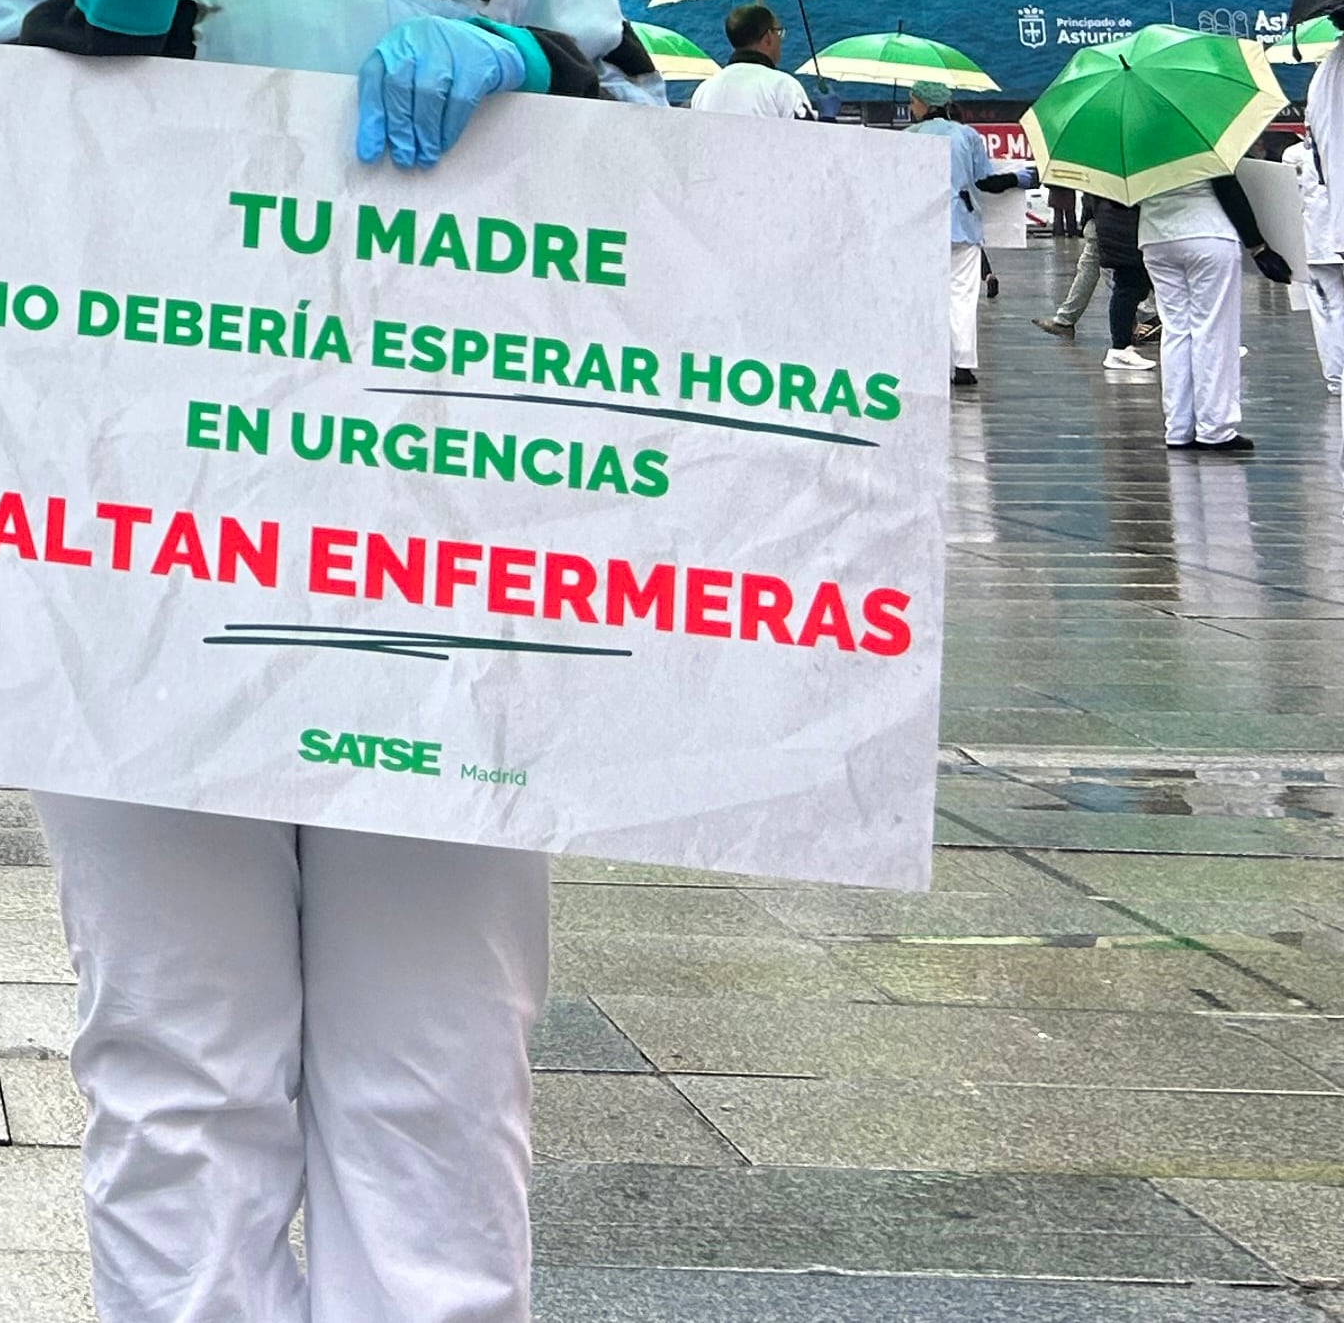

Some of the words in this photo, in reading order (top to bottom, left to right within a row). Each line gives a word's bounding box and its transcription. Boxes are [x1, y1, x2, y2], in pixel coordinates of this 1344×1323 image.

[1056, 16, 1116, 29] Principado
[1118, 17, 1133, 28] de
[1254, 9, 1290, 32] Ast
[228, 190, 333, 255] TU
[355, 203, 628, 287] MADRE
[76, 298, 353, 364] DEBERÍA
[370, 319, 661, 397] ESPERAR
[678, 351, 902, 421] HORAS
[185, 399, 271, 456] EN
[290, 411, 671, 498] URGENCIAS
[307, 524, 913, 657] ENFERMERAS
[297, 728, 443, 777] SATSE
[459, 763, 528, 787] Madrid
